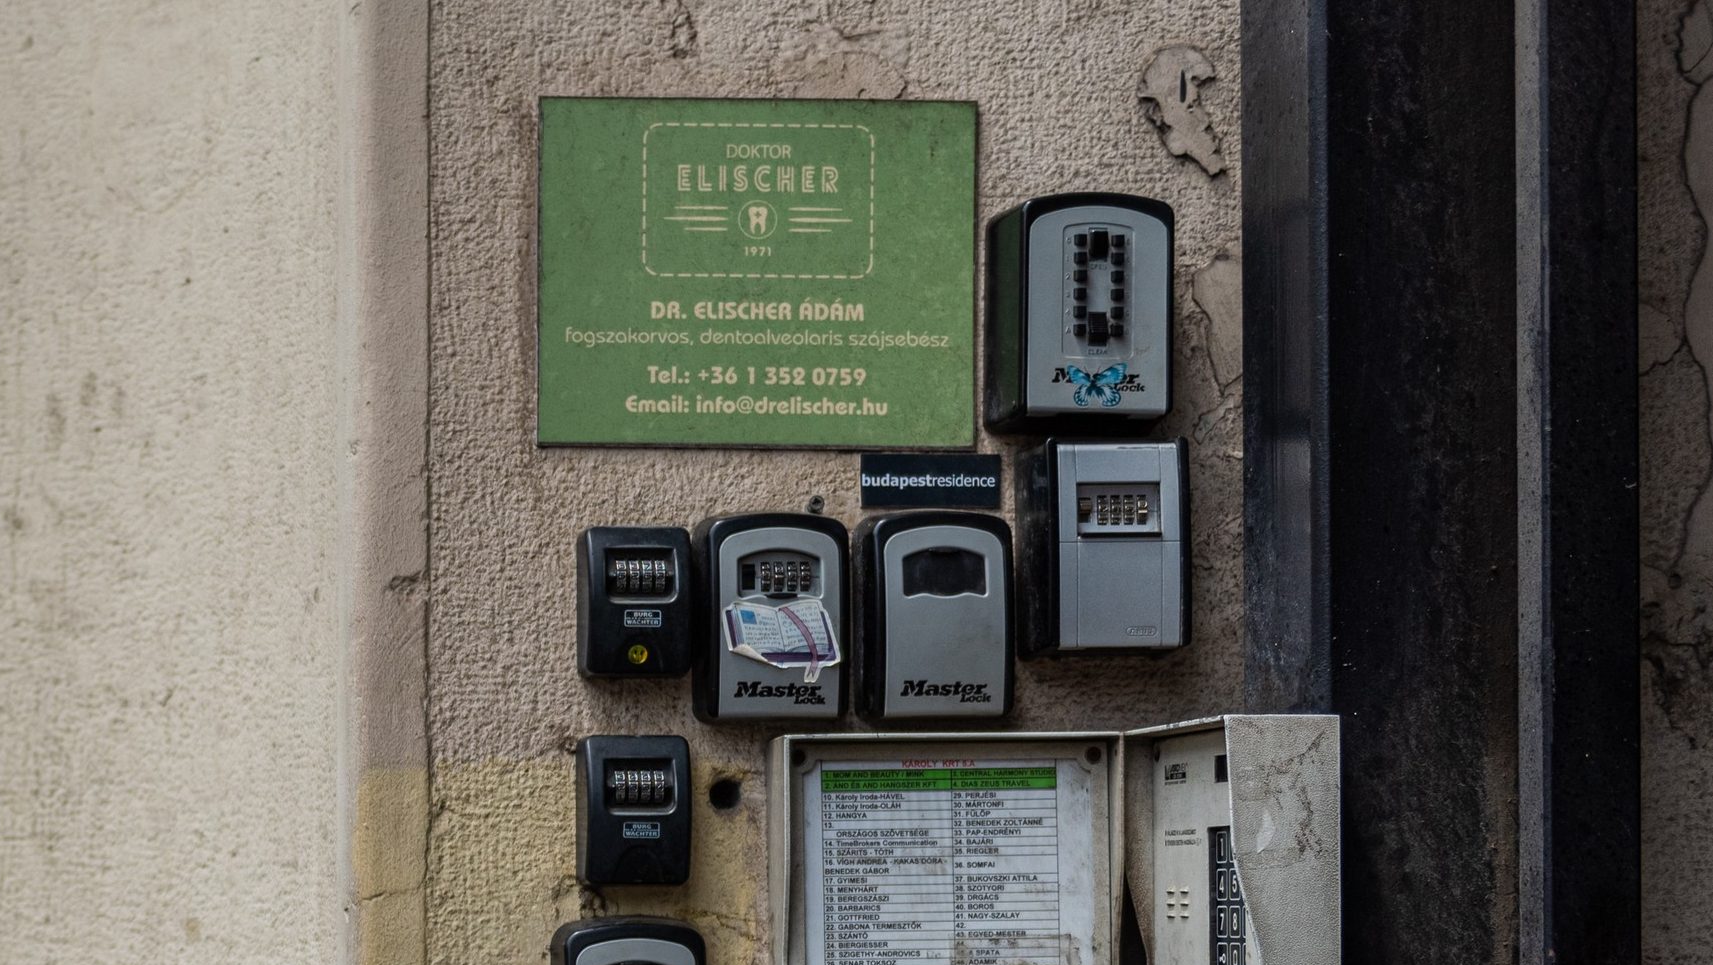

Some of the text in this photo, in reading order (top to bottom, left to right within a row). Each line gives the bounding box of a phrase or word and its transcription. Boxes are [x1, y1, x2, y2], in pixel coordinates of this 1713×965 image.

[726, 144, 792, 159] DOKTOR
[676, 164, 838, 193] ELISCHER
[744, 246, 772, 257] 1971
[650, 297, 865, 321] DR. ELISCHER ÁDÁM
[565, 326, 949, 351] fogszakorvos, dentoalveolaris szájsebész
[648, 366, 867, 386] Tel.: +36 1 352 0759
[625, 395, 888, 416] Email: info@drelischer.hu
[861, 473, 996, 490] budapestresidence
[734, 681, 822, 698] Master
[900, 679, 988, 697] Master
[793, 695, 825, 705] Lock
[959, 693, 991, 703] Lock
[942, 760, 960, 768] KRT
[1219, 875, 1224, 893] 4
[1219, 913, 1238, 930] 7 8
